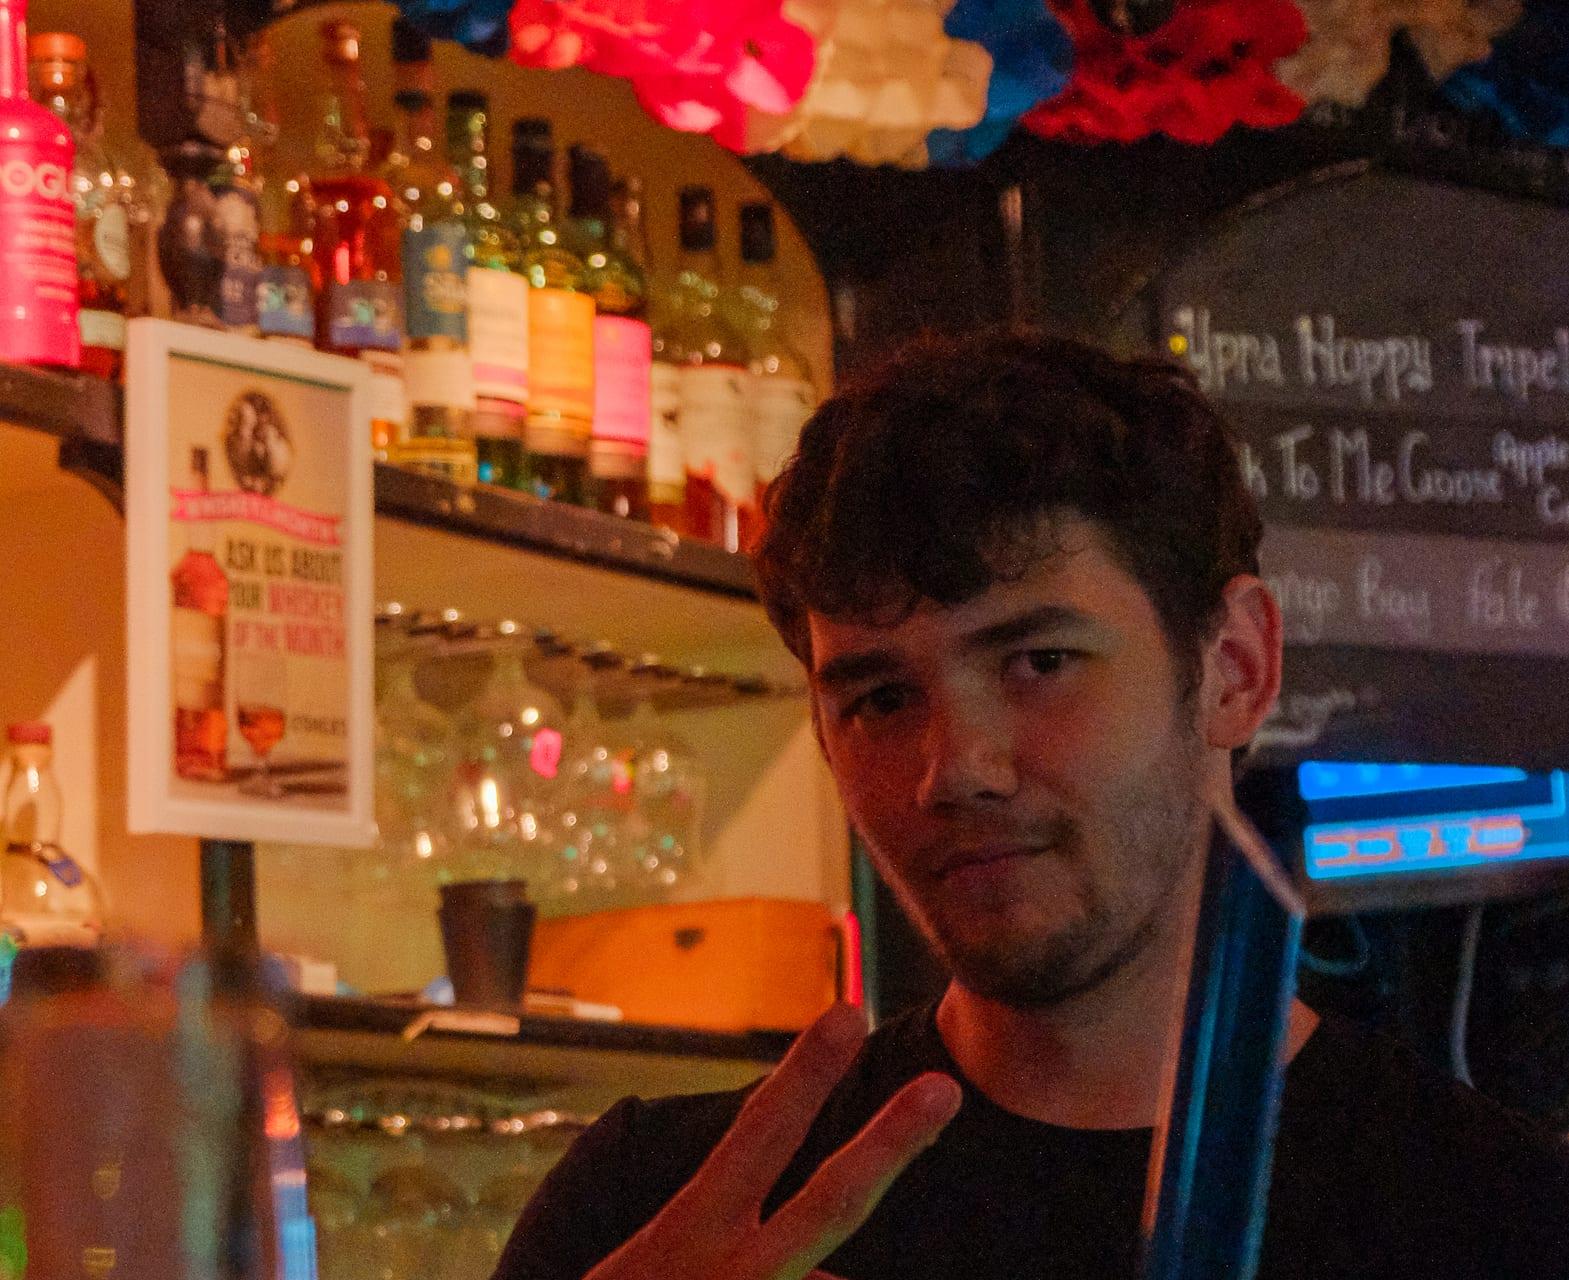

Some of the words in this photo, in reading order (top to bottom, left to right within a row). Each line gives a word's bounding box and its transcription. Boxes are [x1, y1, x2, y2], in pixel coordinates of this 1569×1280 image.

[1297, 313, 1433, 400] Hoppy
[1273, 424, 1320, 500] To
[1328, 428, 1397, 505] Me
[227, 539, 255, 571] ASK
